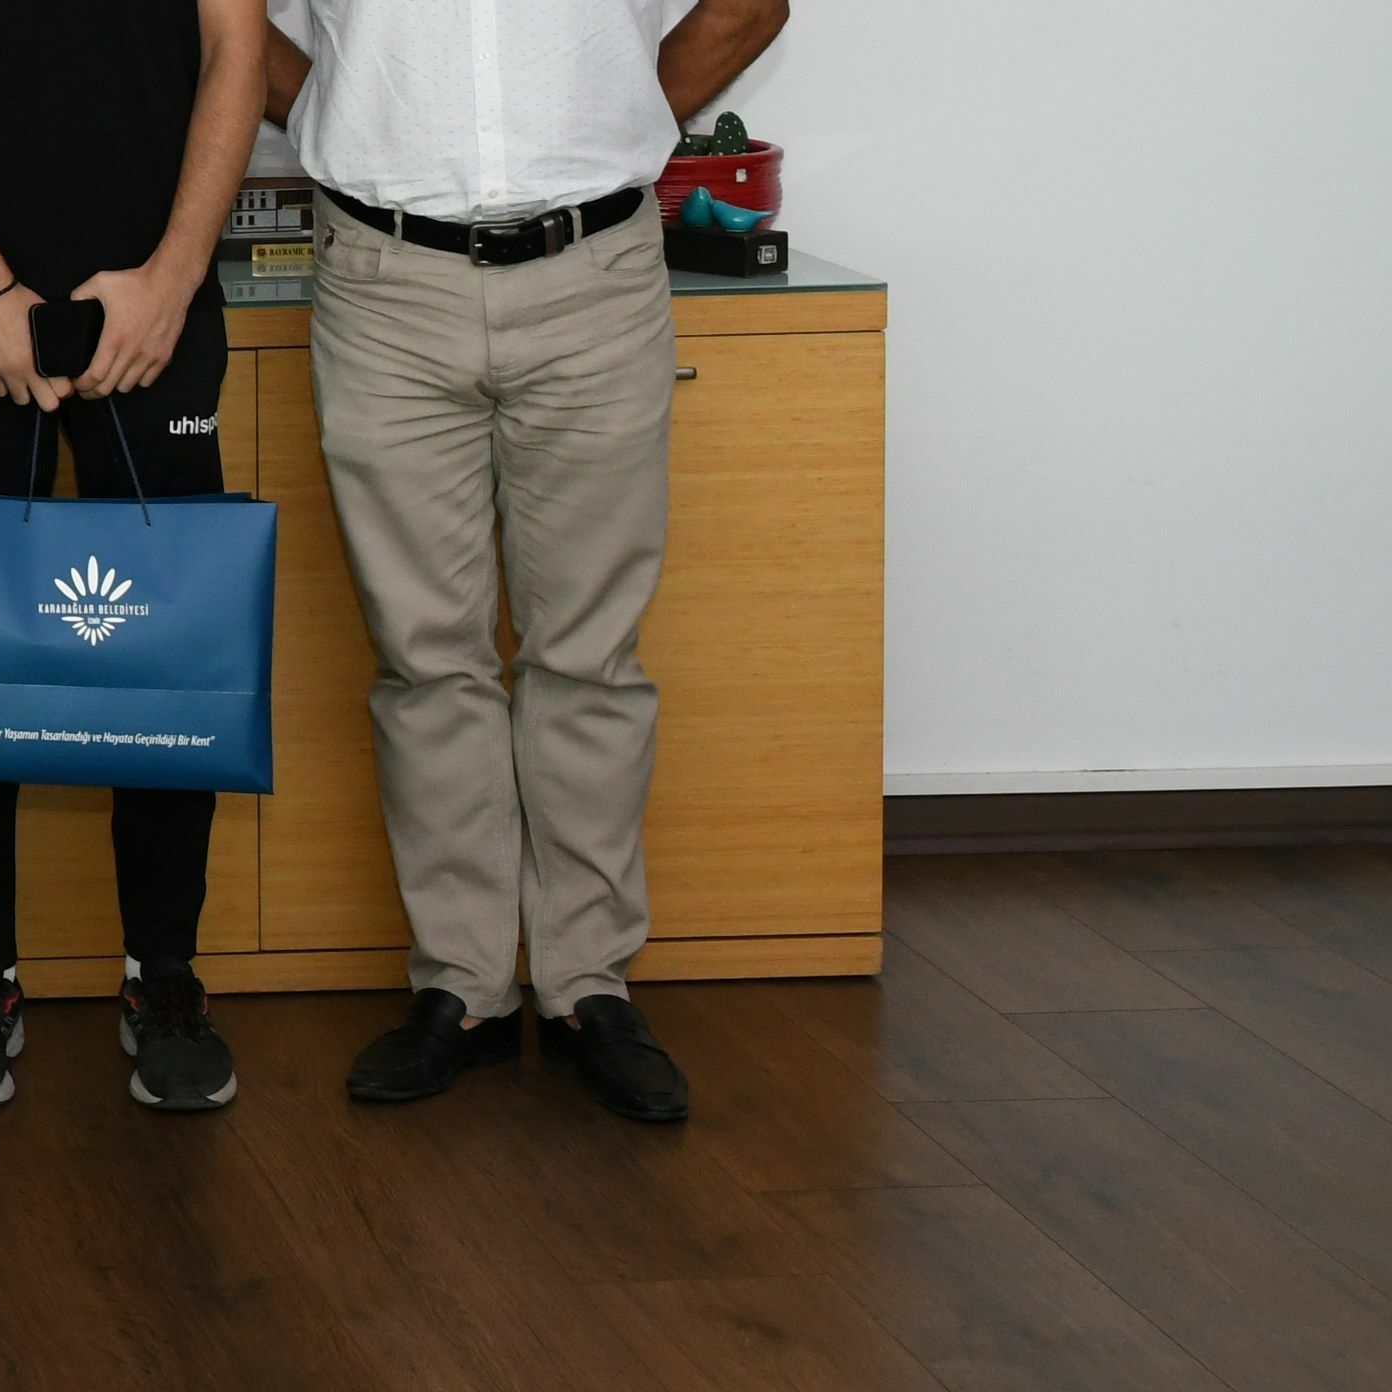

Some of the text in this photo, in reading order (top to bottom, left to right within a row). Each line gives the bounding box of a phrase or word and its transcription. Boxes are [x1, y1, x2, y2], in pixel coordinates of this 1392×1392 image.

[169, 412, 217, 436] uhlsp
[38, 602, 149, 616] KARABAĞLAR BELEDİYESİ
[92, 734, 102, 742] ve
[103, 732, 133, 745] Hayata
[177, 734, 190, 746] Bir
